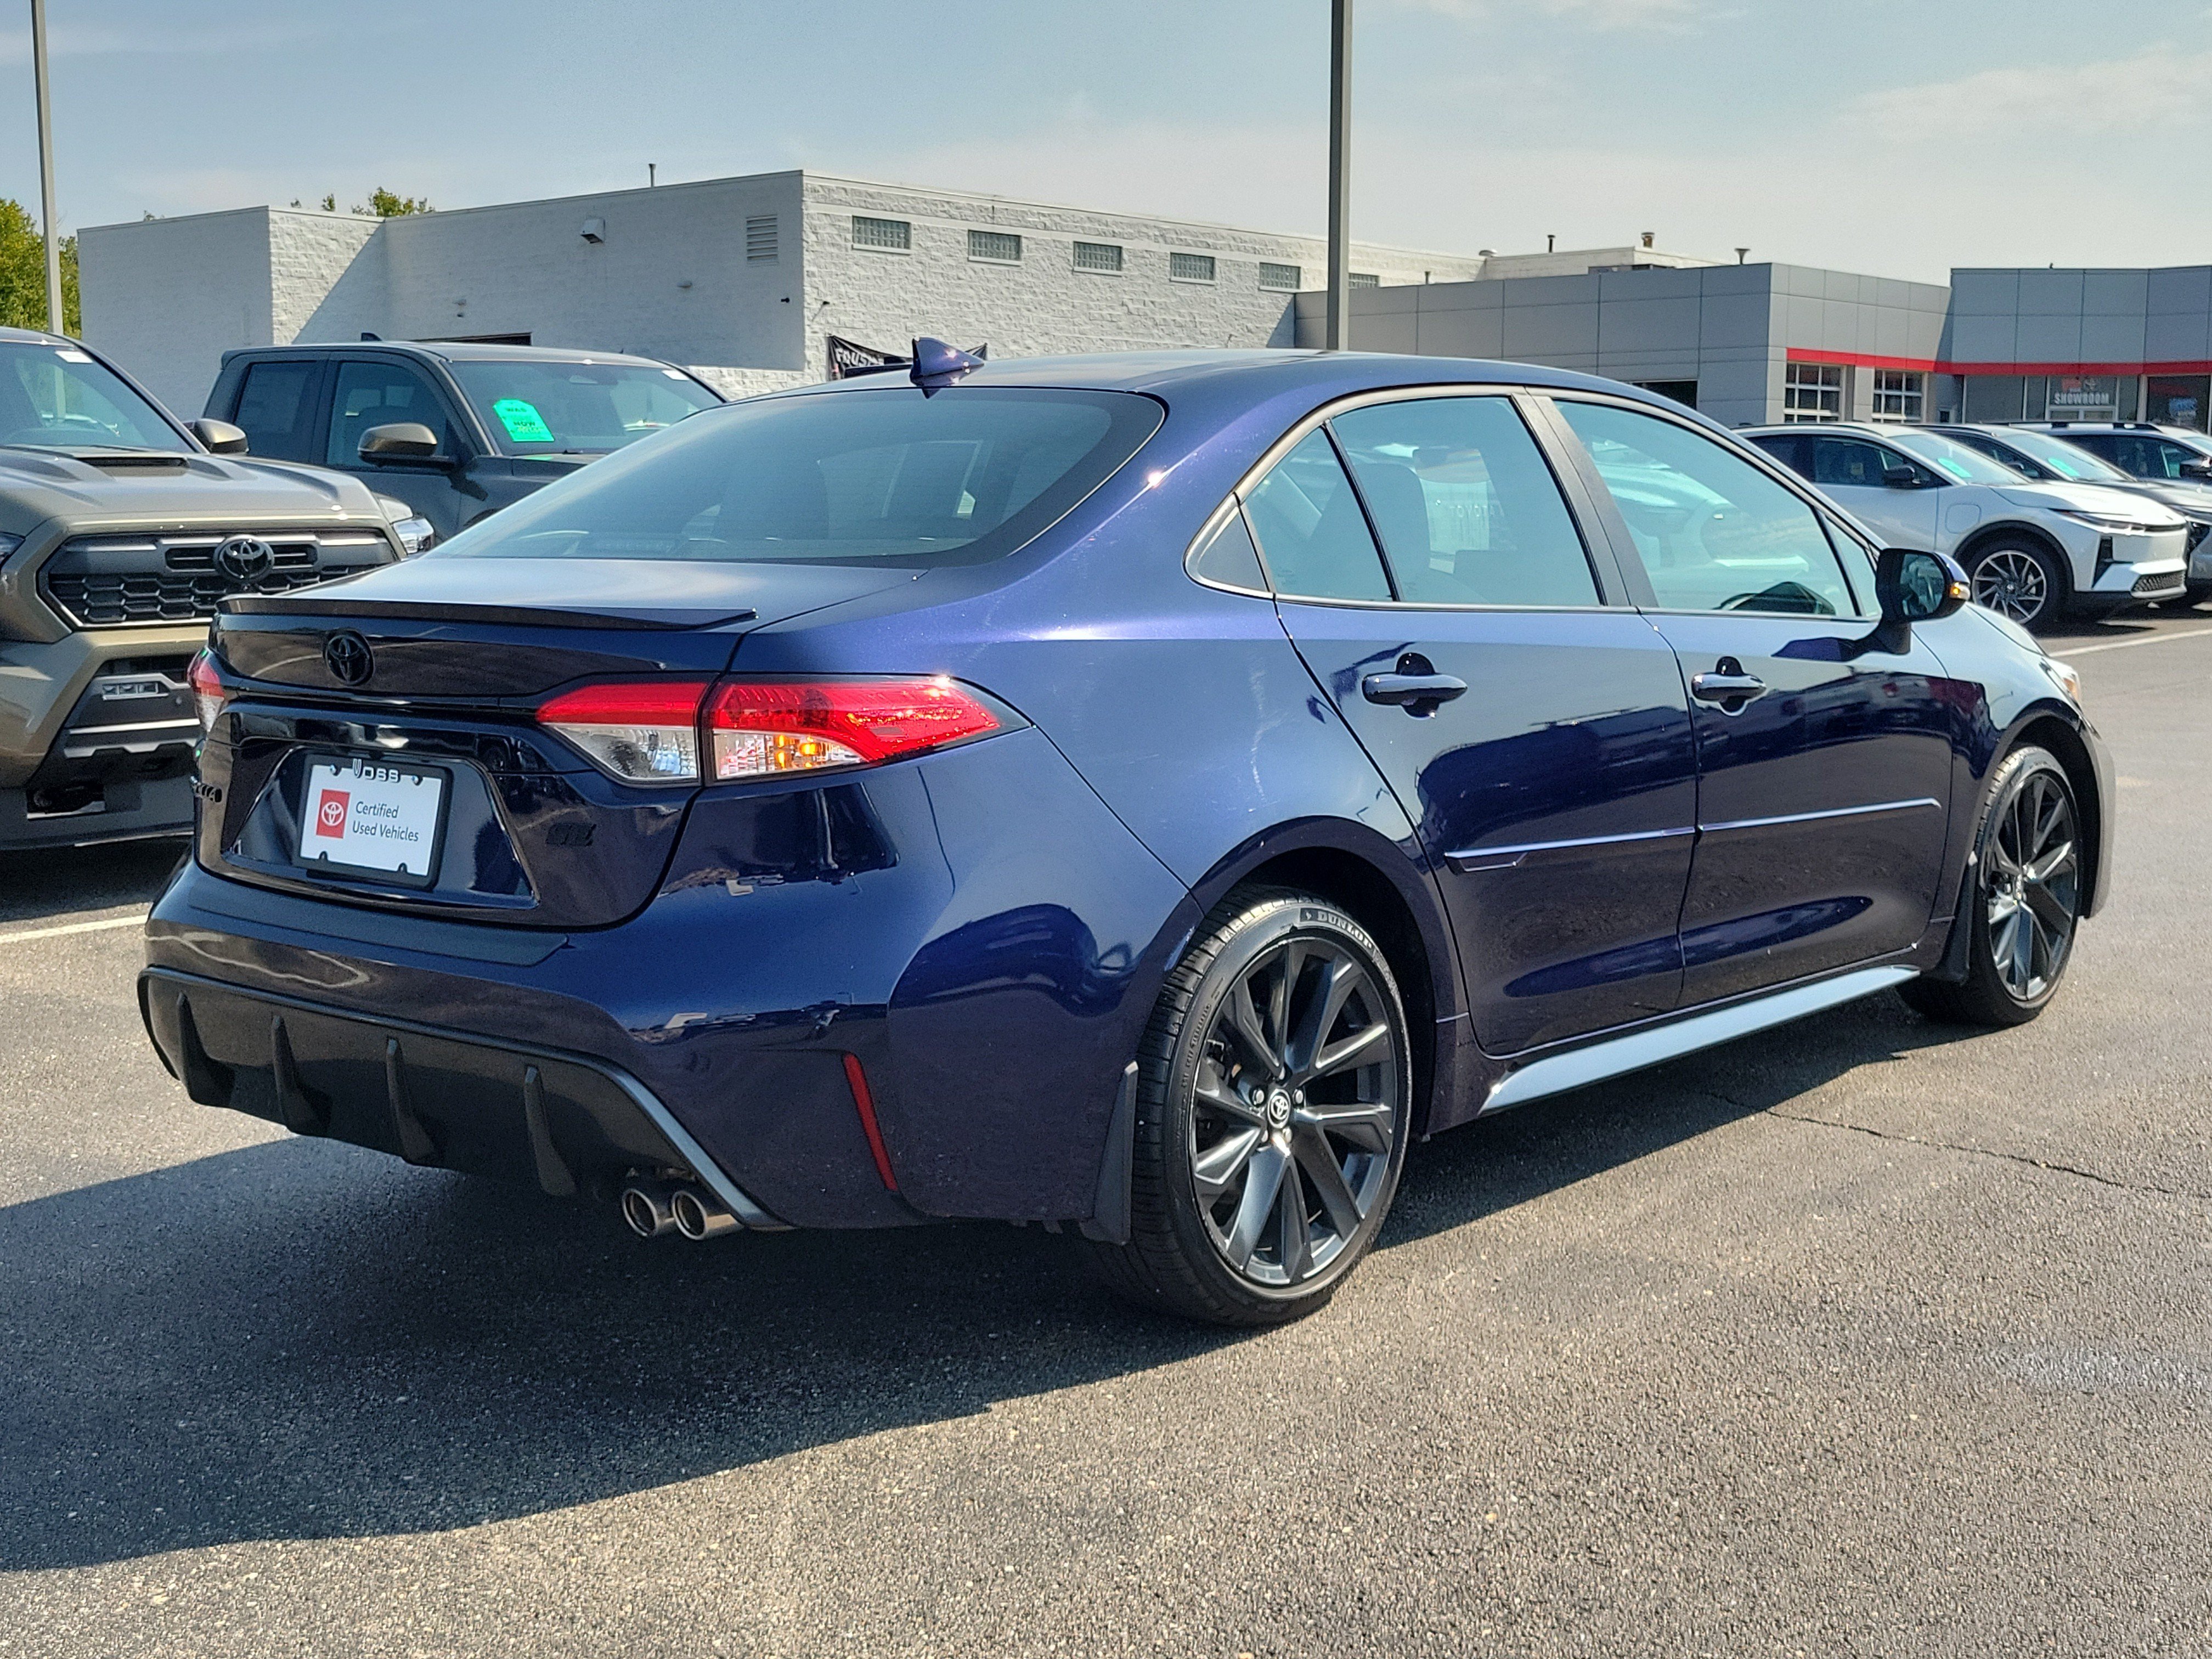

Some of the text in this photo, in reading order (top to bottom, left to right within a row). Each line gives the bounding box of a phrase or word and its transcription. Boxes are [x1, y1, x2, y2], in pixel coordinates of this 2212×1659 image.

[2054, 392, 2110, 405] SHOWROOM
[353, 758, 399, 783] VOSS
[356, 801, 399, 819] Certified
[352, 821, 419, 842] Used Vehicles
[1317, 911, 1372, 949] DUNLOP
